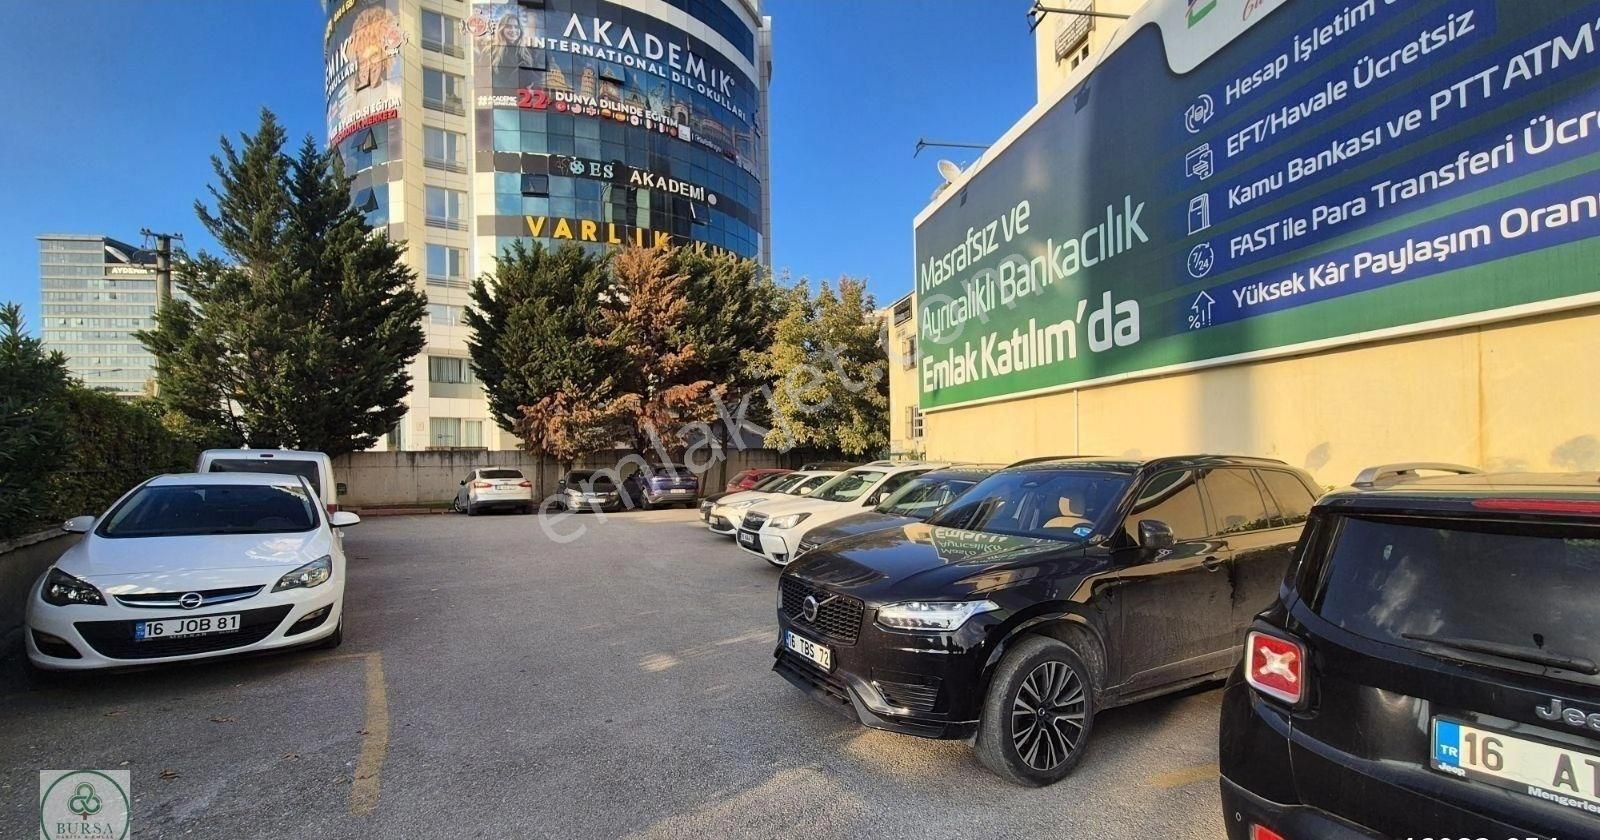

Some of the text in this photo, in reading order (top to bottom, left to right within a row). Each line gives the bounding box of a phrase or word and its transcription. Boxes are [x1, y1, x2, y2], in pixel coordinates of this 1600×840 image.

[517, 88, 548, 110] 22
[526, 36, 667, 77] INTERNATIONAL
[697, 83, 746, 121] OKULLARI
[1225, 0, 1376, 105] Hesap İşletim
[1227, 10, 1475, 158] EFT/Havale Ücretsiz
[1228, 171, 1283, 209] Kamu
[1287, 126, 1381, 187] Bankası
[1386, 109, 1422, 138] ve
[1430, 65, 1499, 121] PTT
[525, 216, 670, 252] VARLIK
[1230, 115, 1600, 259] FAST ile Para Transferi Ücr
[920, 194, 1150, 343] Ayrıcalıklı Bankacılık
[921, 200, 1031, 295] Masrafsız ve
[1232, 193, 1600, 309] Yüksek Kâr Paylaşım Oran
[922, 290, 1141, 394] Emlak Katılım'da
[146, 622, 164, 636] 16
[174, 619, 211, 634] JOB
[217, 616, 237, 630] 81
[800, 639, 815, 659] TBS
[819, 648, 829, 666] 72
[1438, 762, 1466, 777] Jeep
[1439, 744, 1458, 757] TR
[1464, 732, 1504, 771] 16
